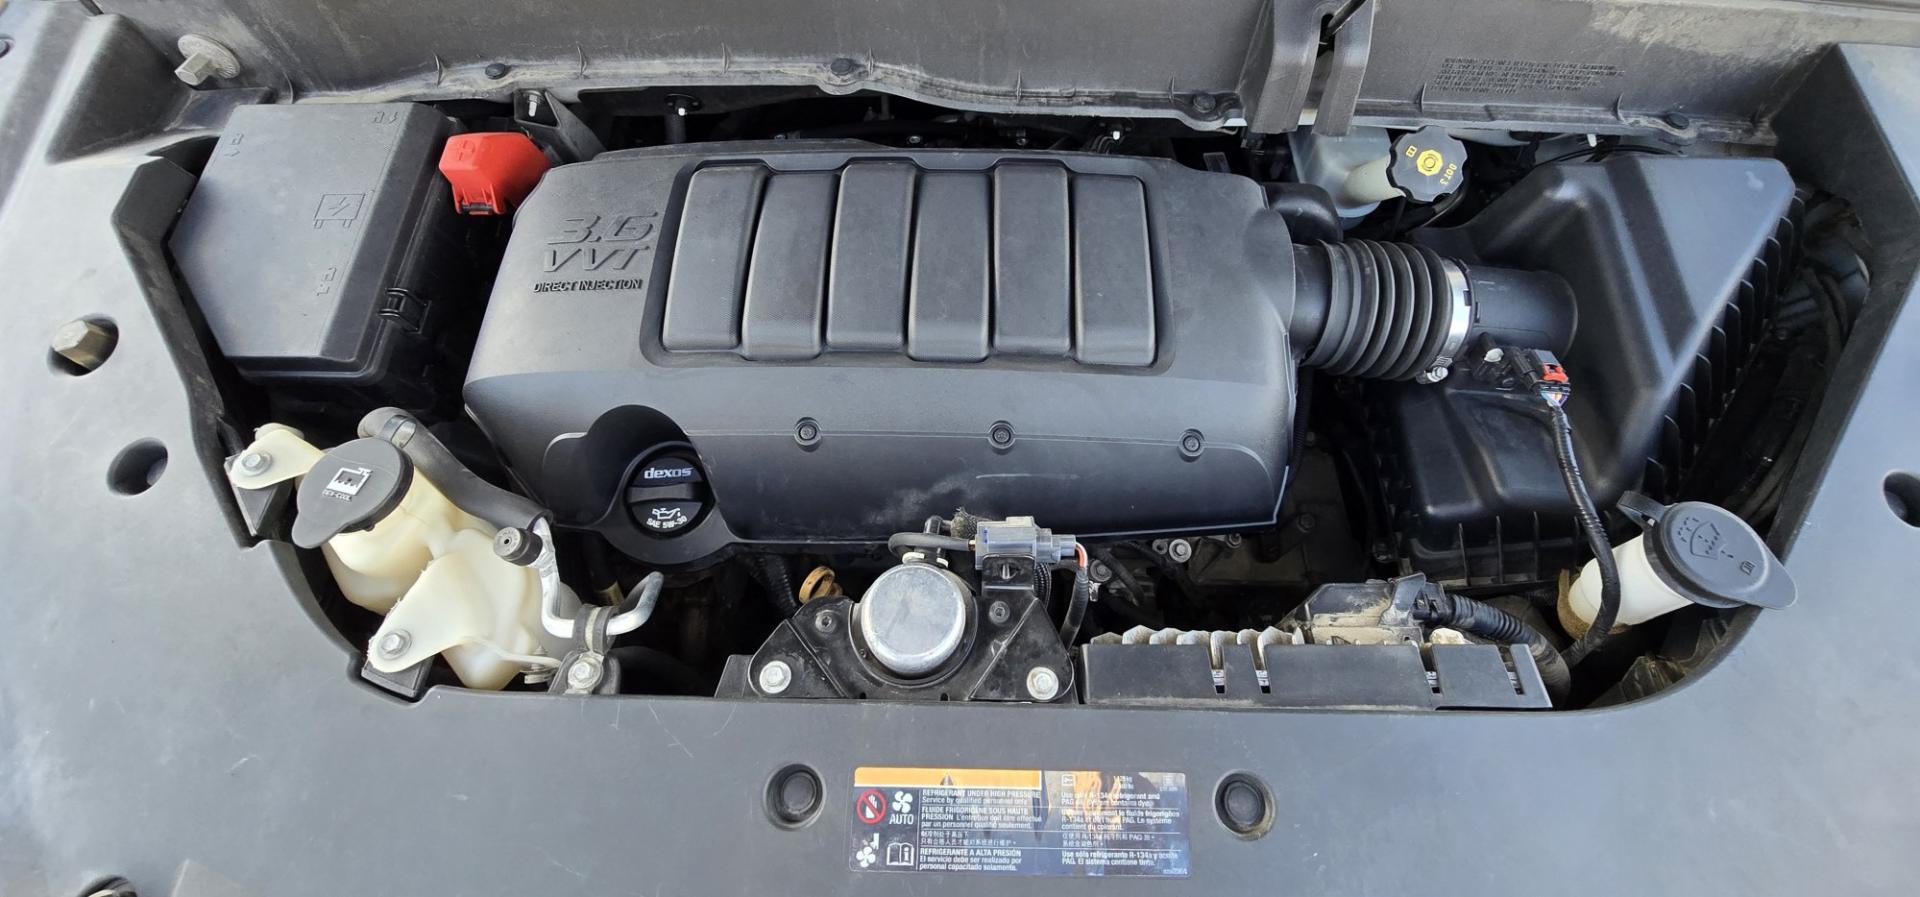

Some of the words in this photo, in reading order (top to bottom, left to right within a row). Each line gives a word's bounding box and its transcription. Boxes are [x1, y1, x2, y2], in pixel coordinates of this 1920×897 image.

[1444, 163, 1457, 180] DOT
[545, 211, 659, 246] 3.6
[543, 247, 650, 272] VVT
[533, 281, 578, 293] DIRECT
[579, 279, 643, 291] INJECTION
[644, 467, 694, 479] dexos
[646, 518, 661, 528] SAE
[662, 515, 688, 529] 5W-30
[922, 789, 965, 797] REFRIGERANT
[990, 790, 1006, 798] HIGH
[1007, 790, 1041, 798] PRESSURE
[889, 814, 914, 824] AUTO
[921, 821, 931, 829] par
[942, 821, 973, 829] personnel
[920, 848, 968, 856] REFRIGERANTE
[1090, 851, 1128, 860] refrigerante
[1011, 857, 1022, 865] por
[1086, 858, 1110, 866] sistema
[919, 863, 946, 871] personal
[948, 863, 982, 872] capacitado
